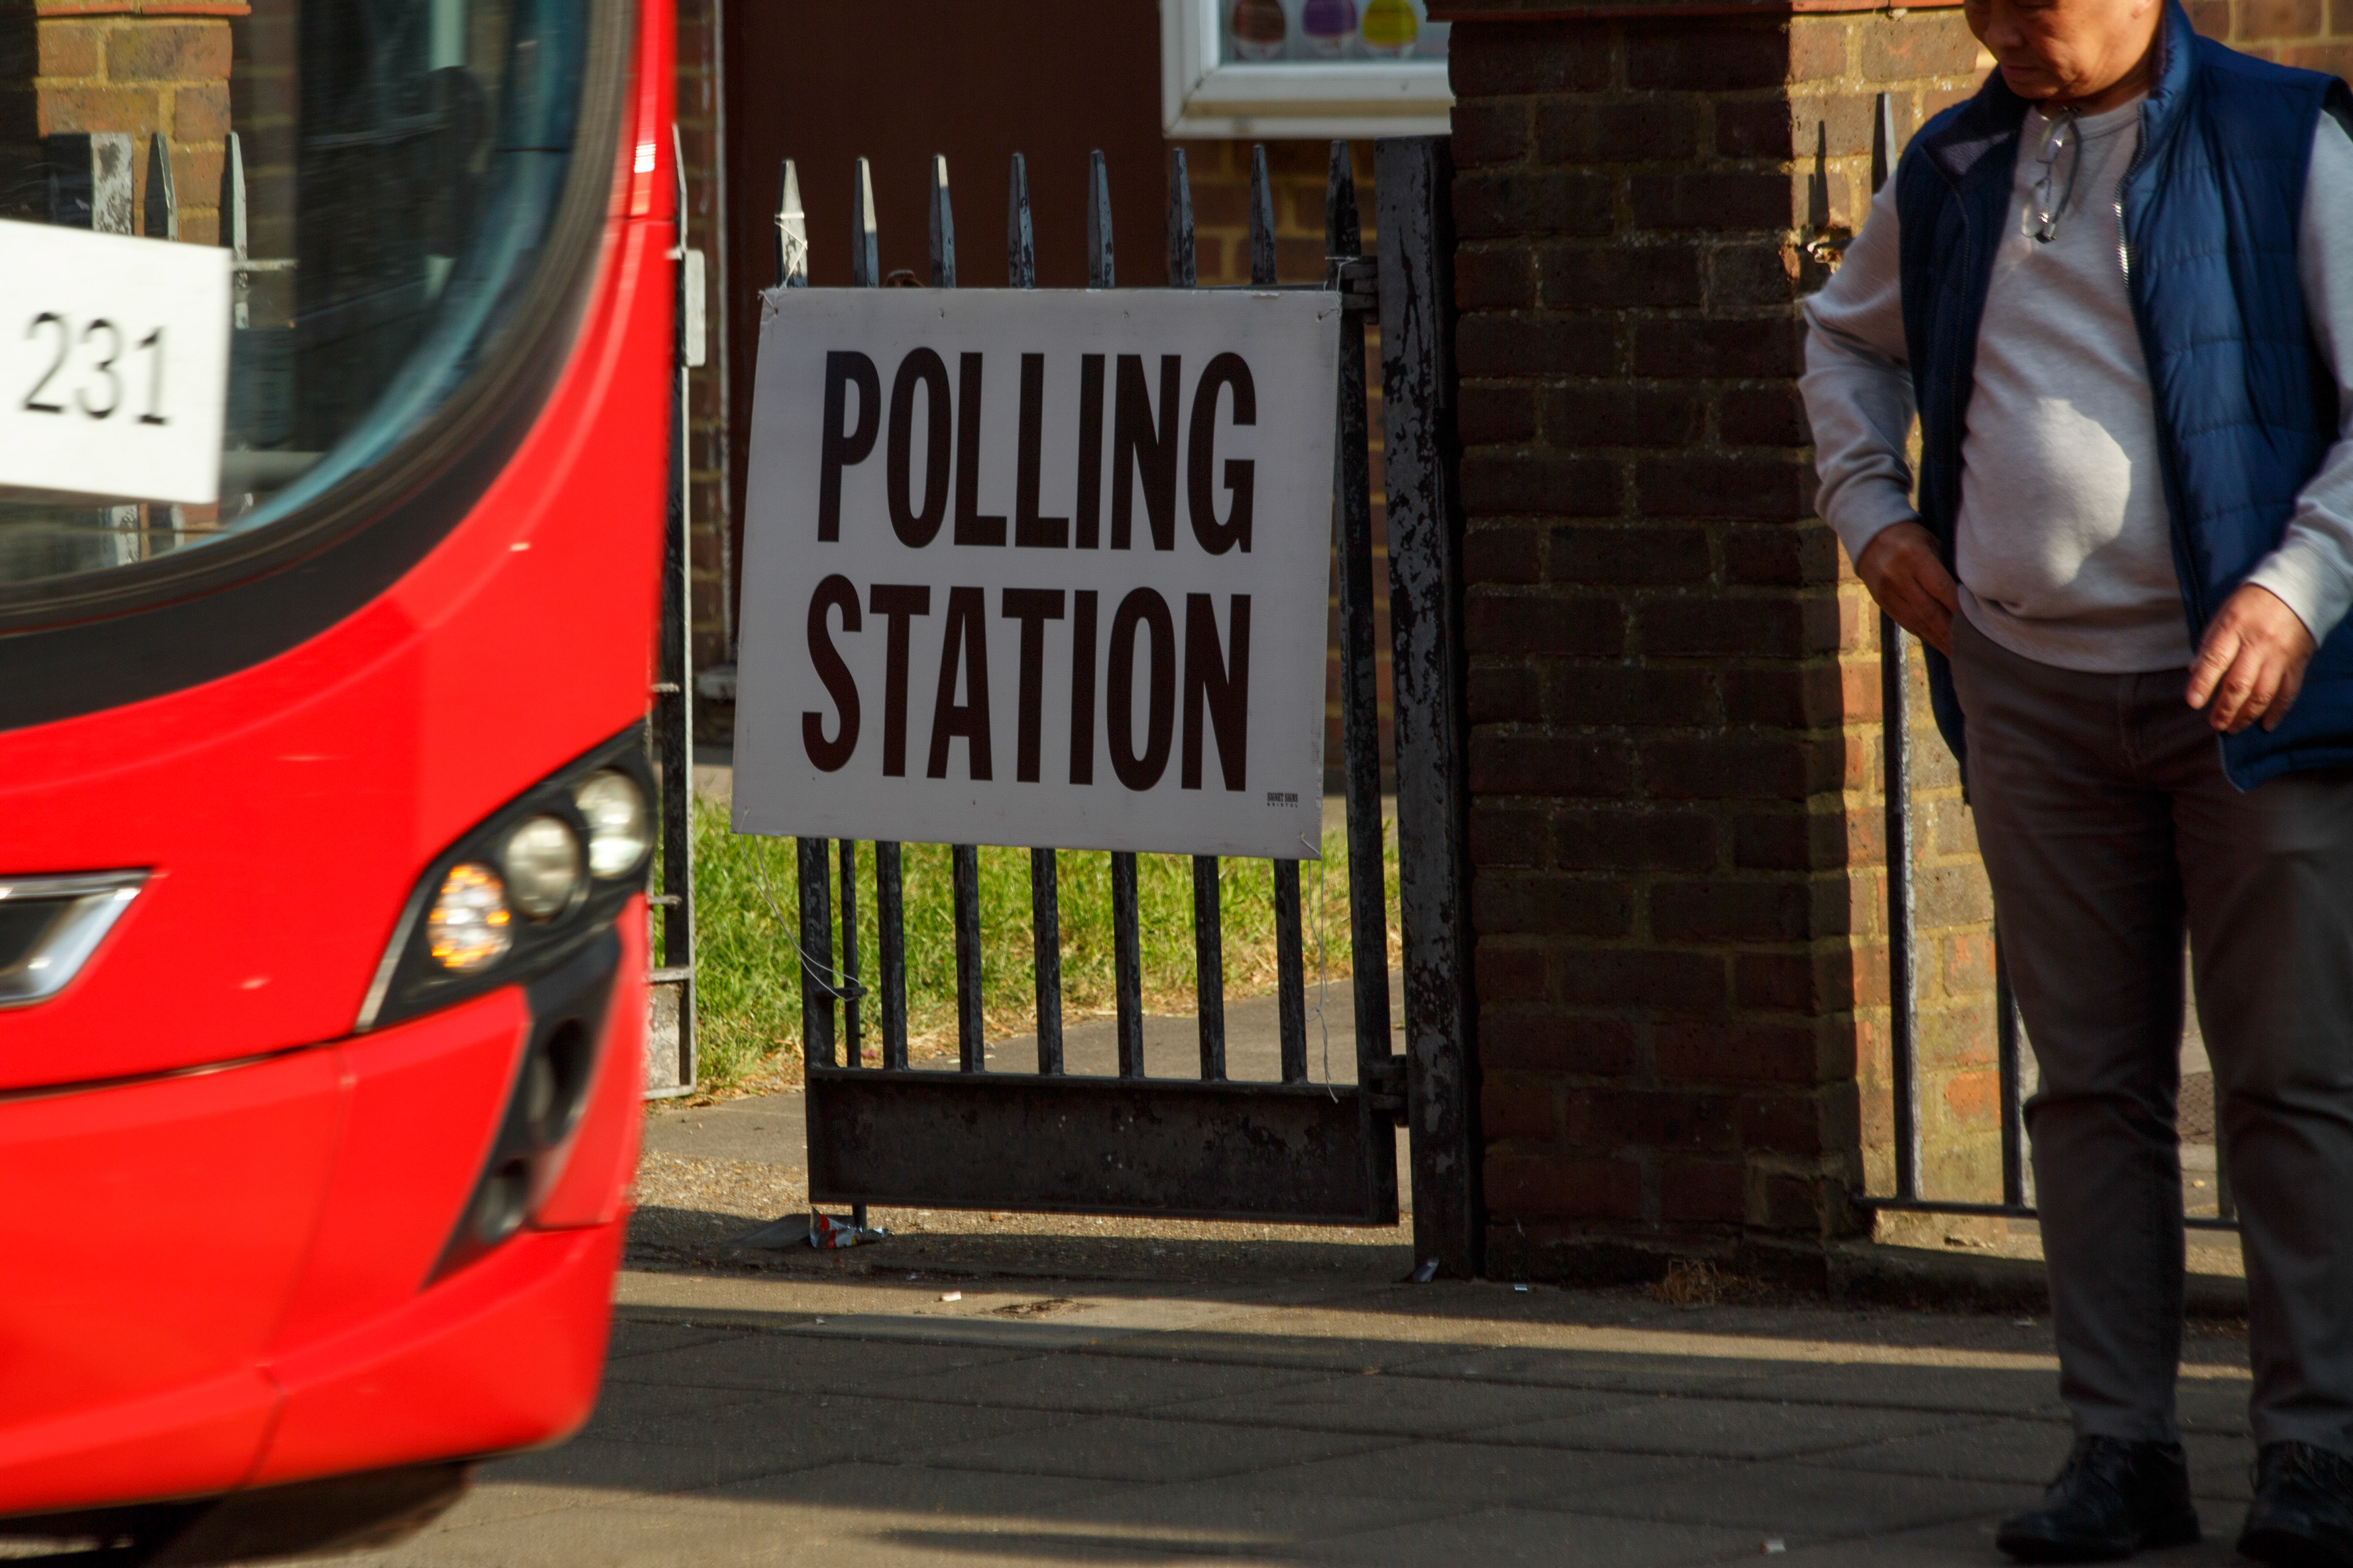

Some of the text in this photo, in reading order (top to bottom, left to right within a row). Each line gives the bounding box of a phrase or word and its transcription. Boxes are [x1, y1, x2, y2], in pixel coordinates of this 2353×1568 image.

[21, 311, 170, 427] 231
[817, 347, 1256, 555] POLLING
[802, 574, 1251, 792] STATION
